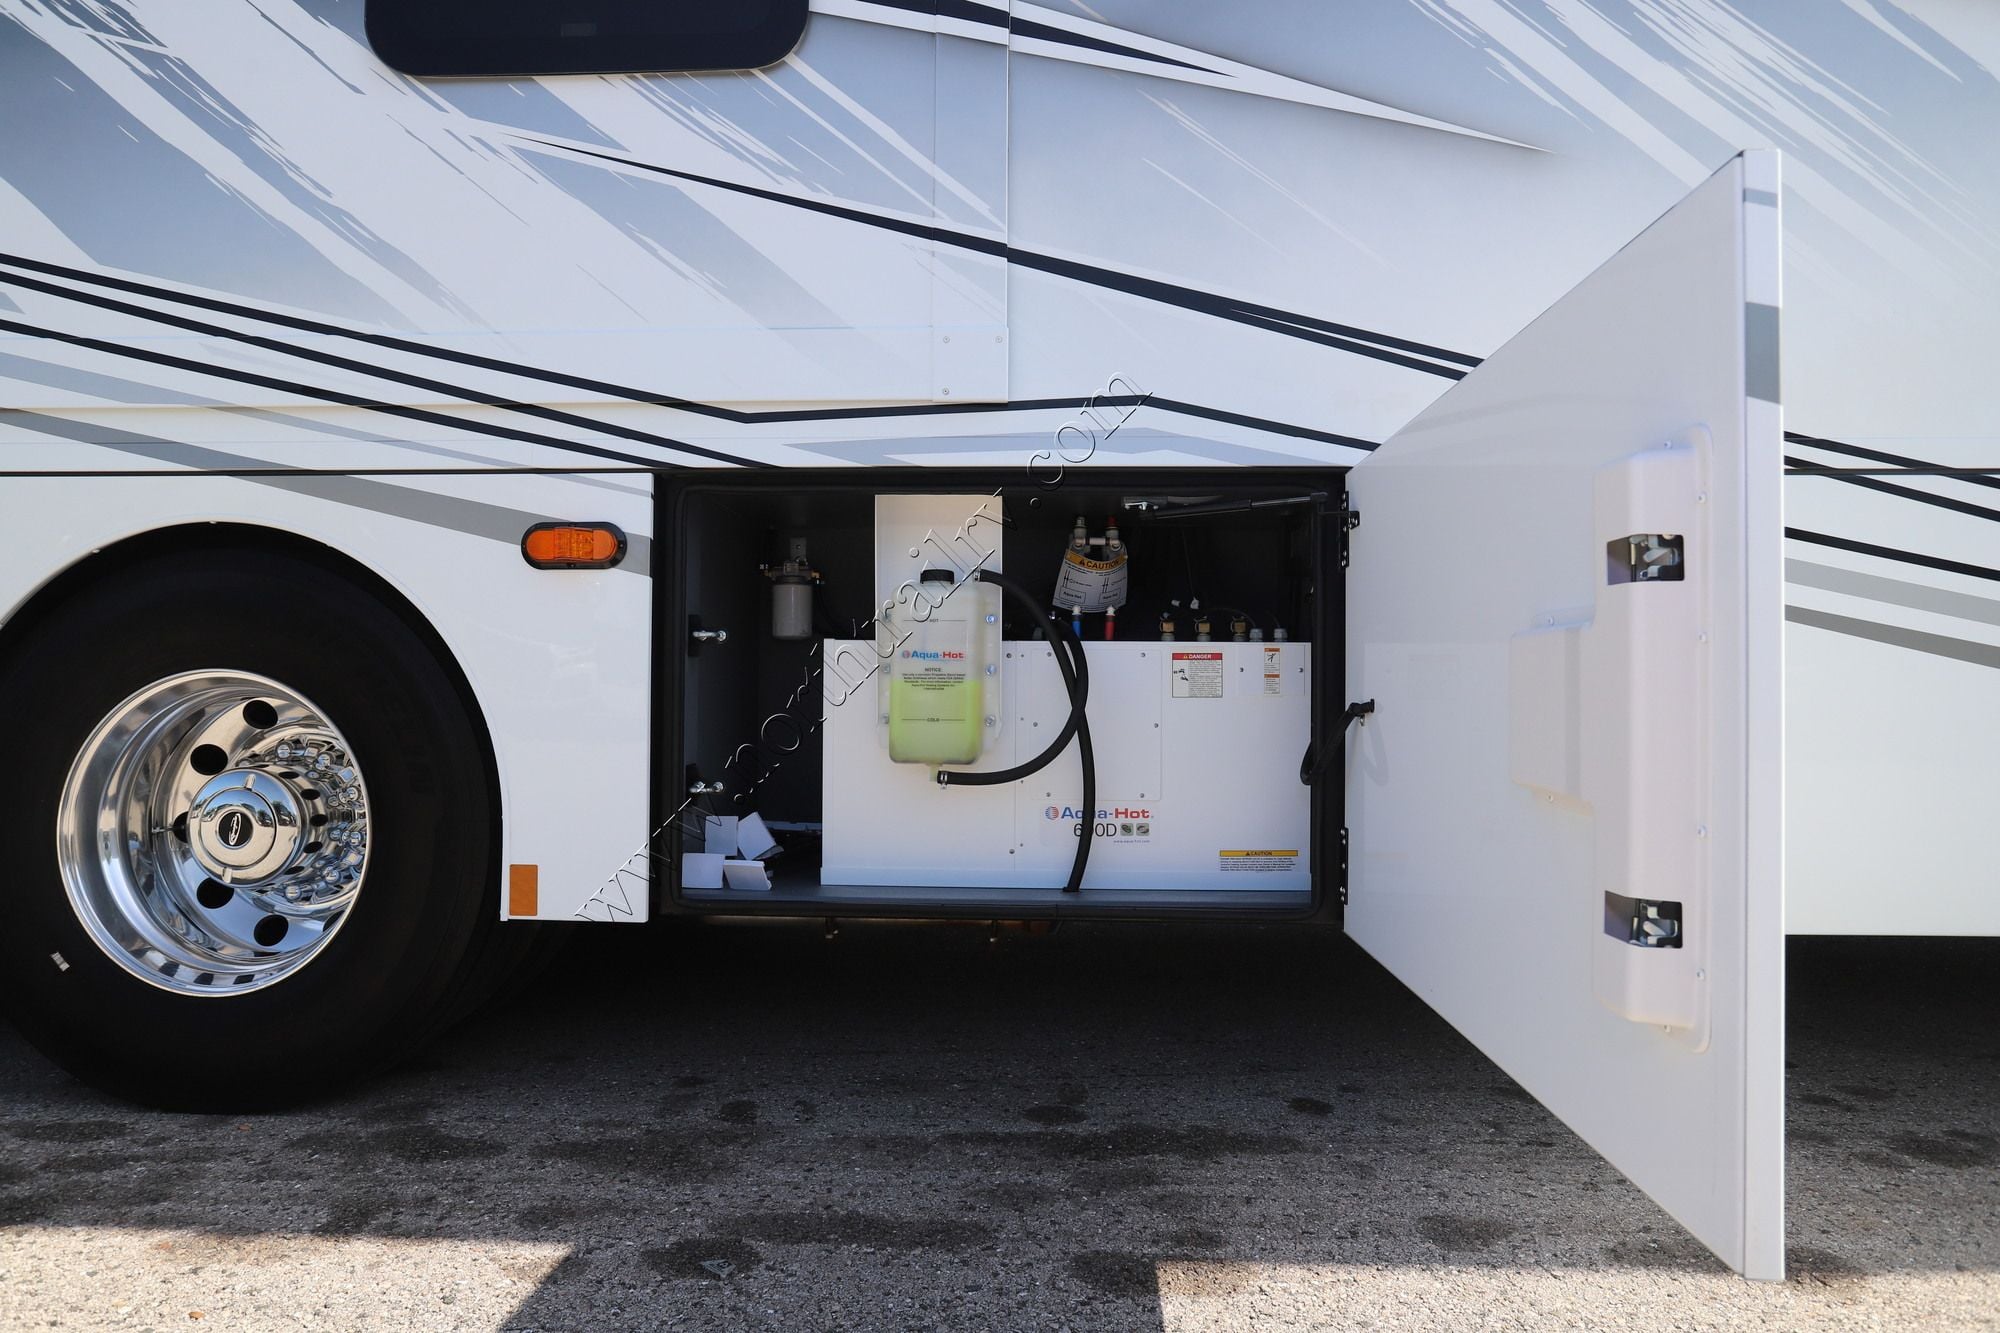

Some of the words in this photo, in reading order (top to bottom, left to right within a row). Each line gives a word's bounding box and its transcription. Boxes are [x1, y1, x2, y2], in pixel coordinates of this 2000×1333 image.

[1086, 559, 1120, 570] CAUTION
[911, 650, 965, 660] Aqua-Hot
[1061, 806, 1150, 820] Aqa-Hot
[1073, 822, 1118, 837] 60D
